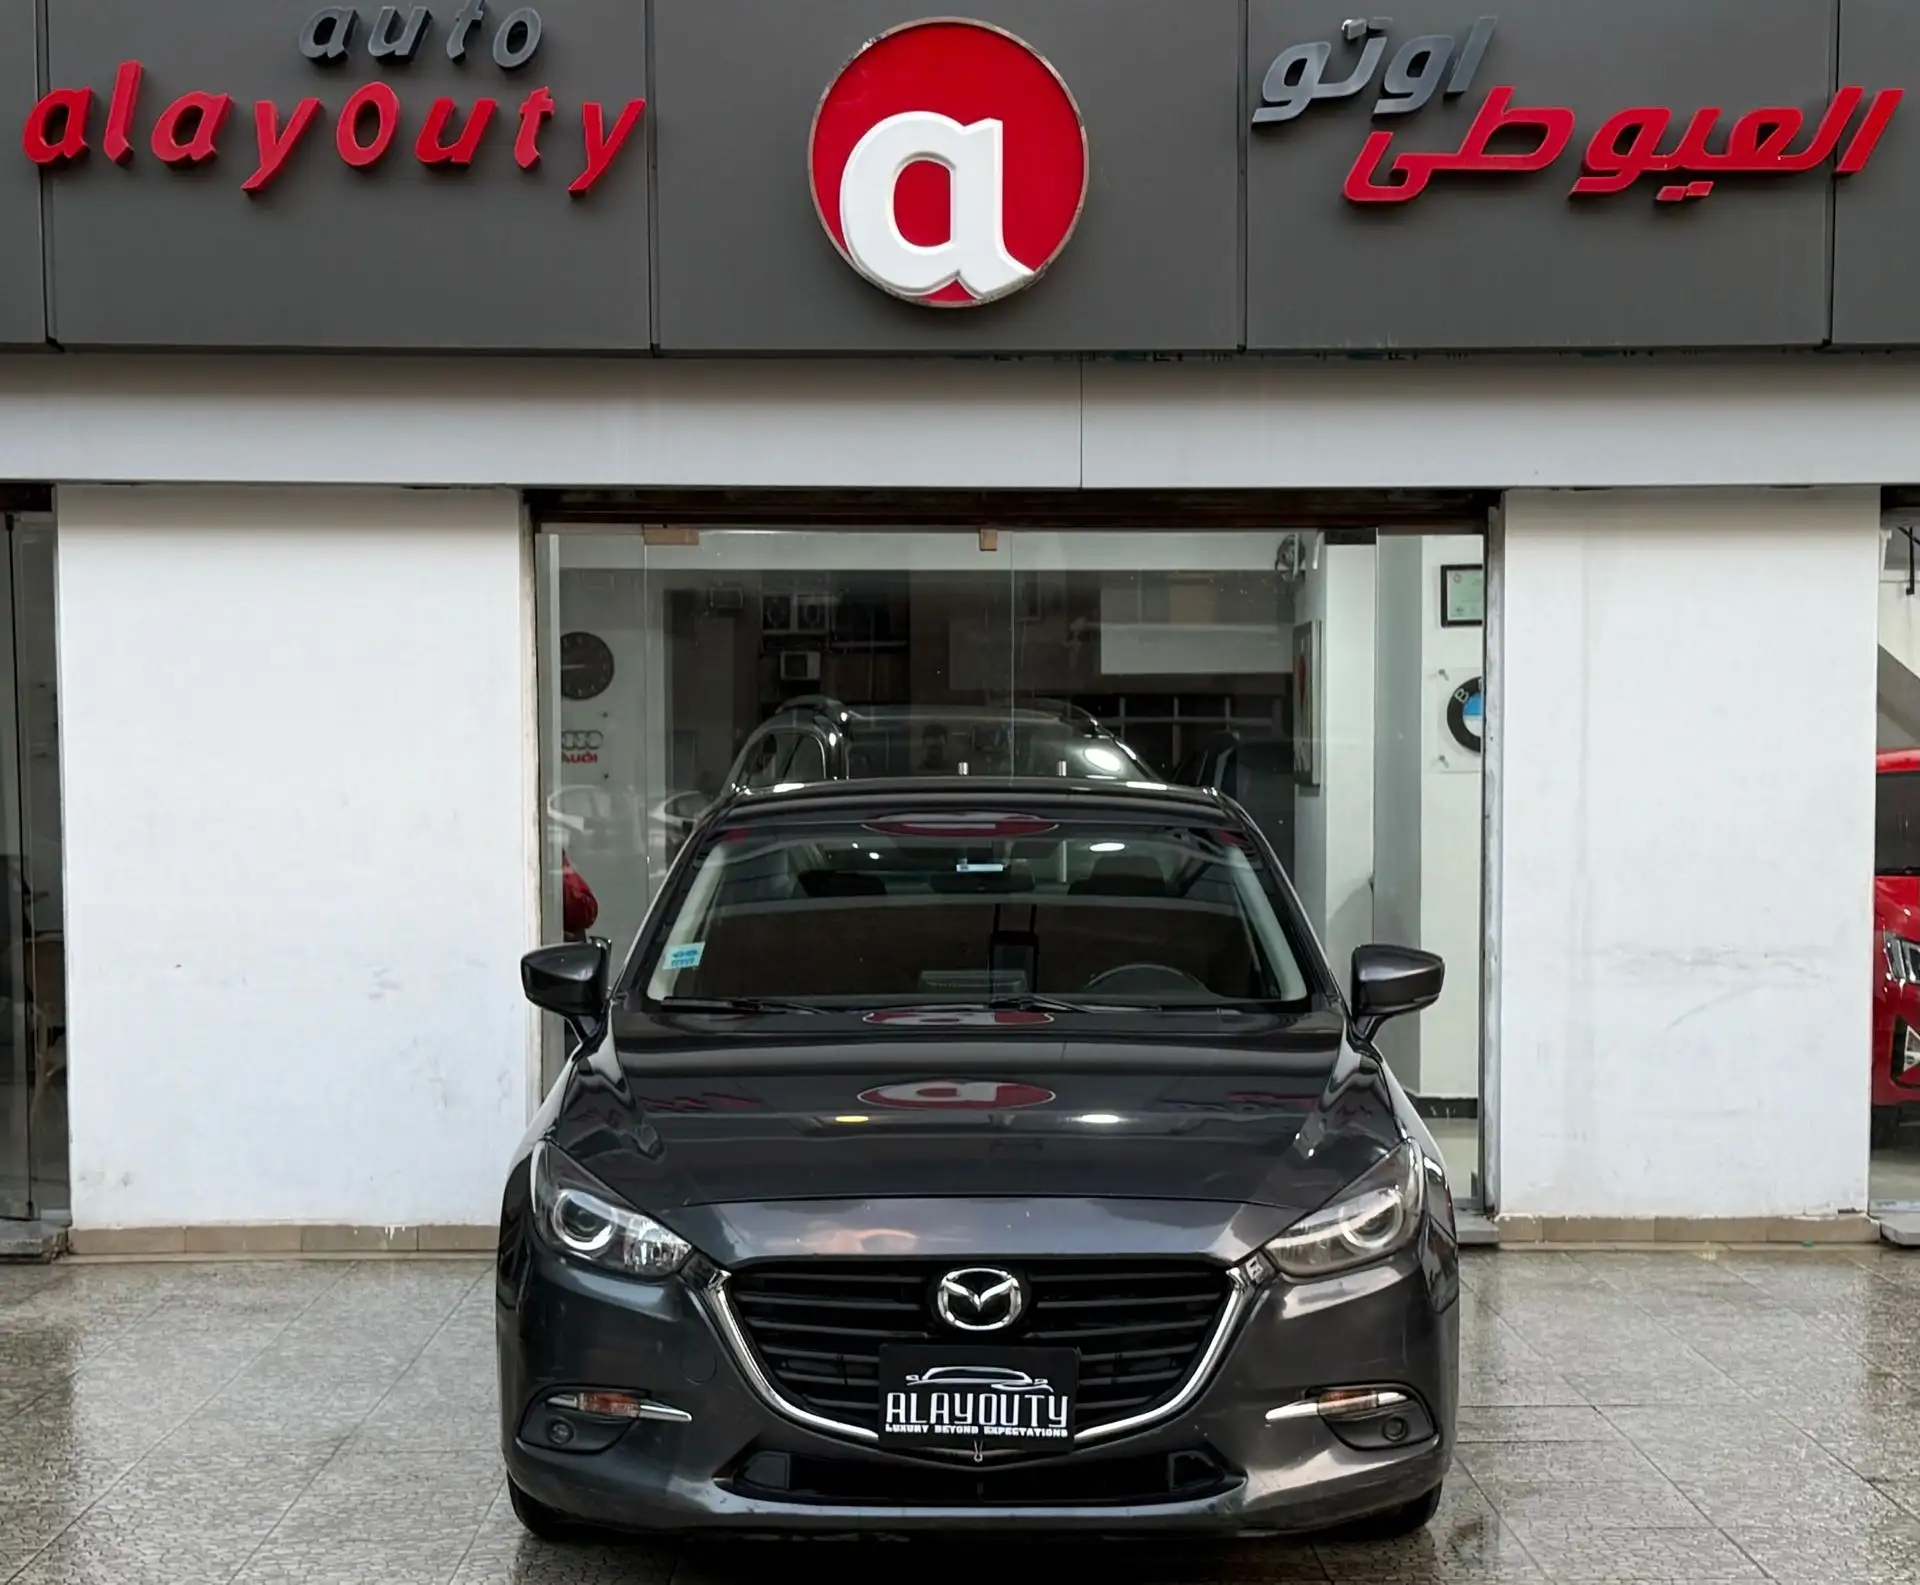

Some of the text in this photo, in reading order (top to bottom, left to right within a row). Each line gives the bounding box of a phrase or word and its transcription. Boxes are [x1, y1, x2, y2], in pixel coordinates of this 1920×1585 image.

[300, 0, 541, 68] auto
[839, 110, 1035, 299] a
[885, 1423, 1069, 1438] LUXURY BEYOND EXPECTATIONS
[886, 1392, 1069, 1428] ALAYOUTY
